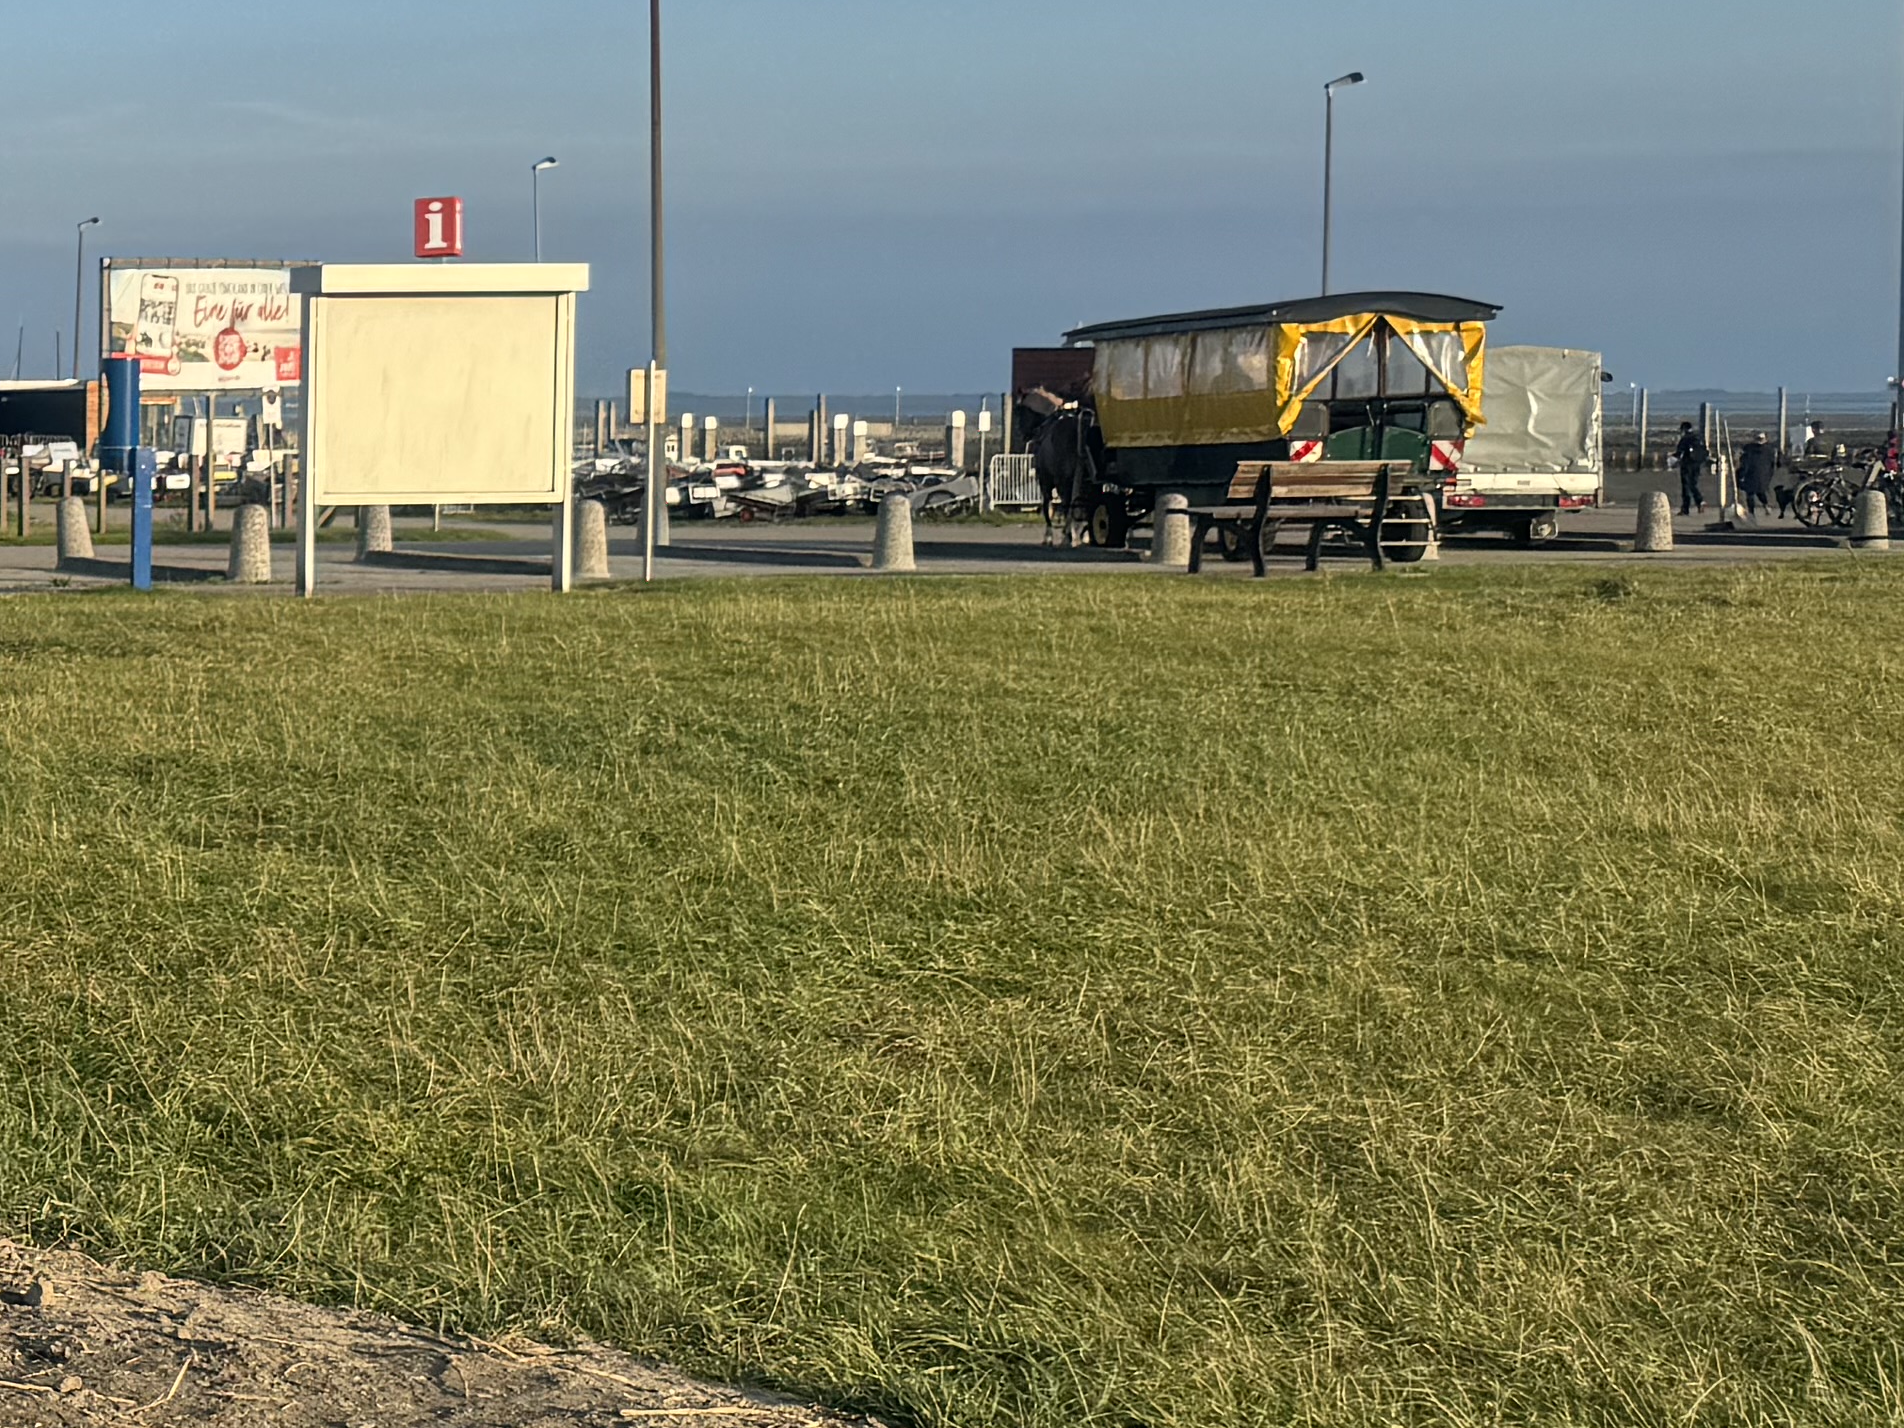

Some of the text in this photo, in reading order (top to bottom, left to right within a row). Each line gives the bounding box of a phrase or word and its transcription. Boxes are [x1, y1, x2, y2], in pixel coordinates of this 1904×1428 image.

[424, 201, 447, 249] i
[194, 295, 228, 327] Eine
[230, 299, 254, 329] für
